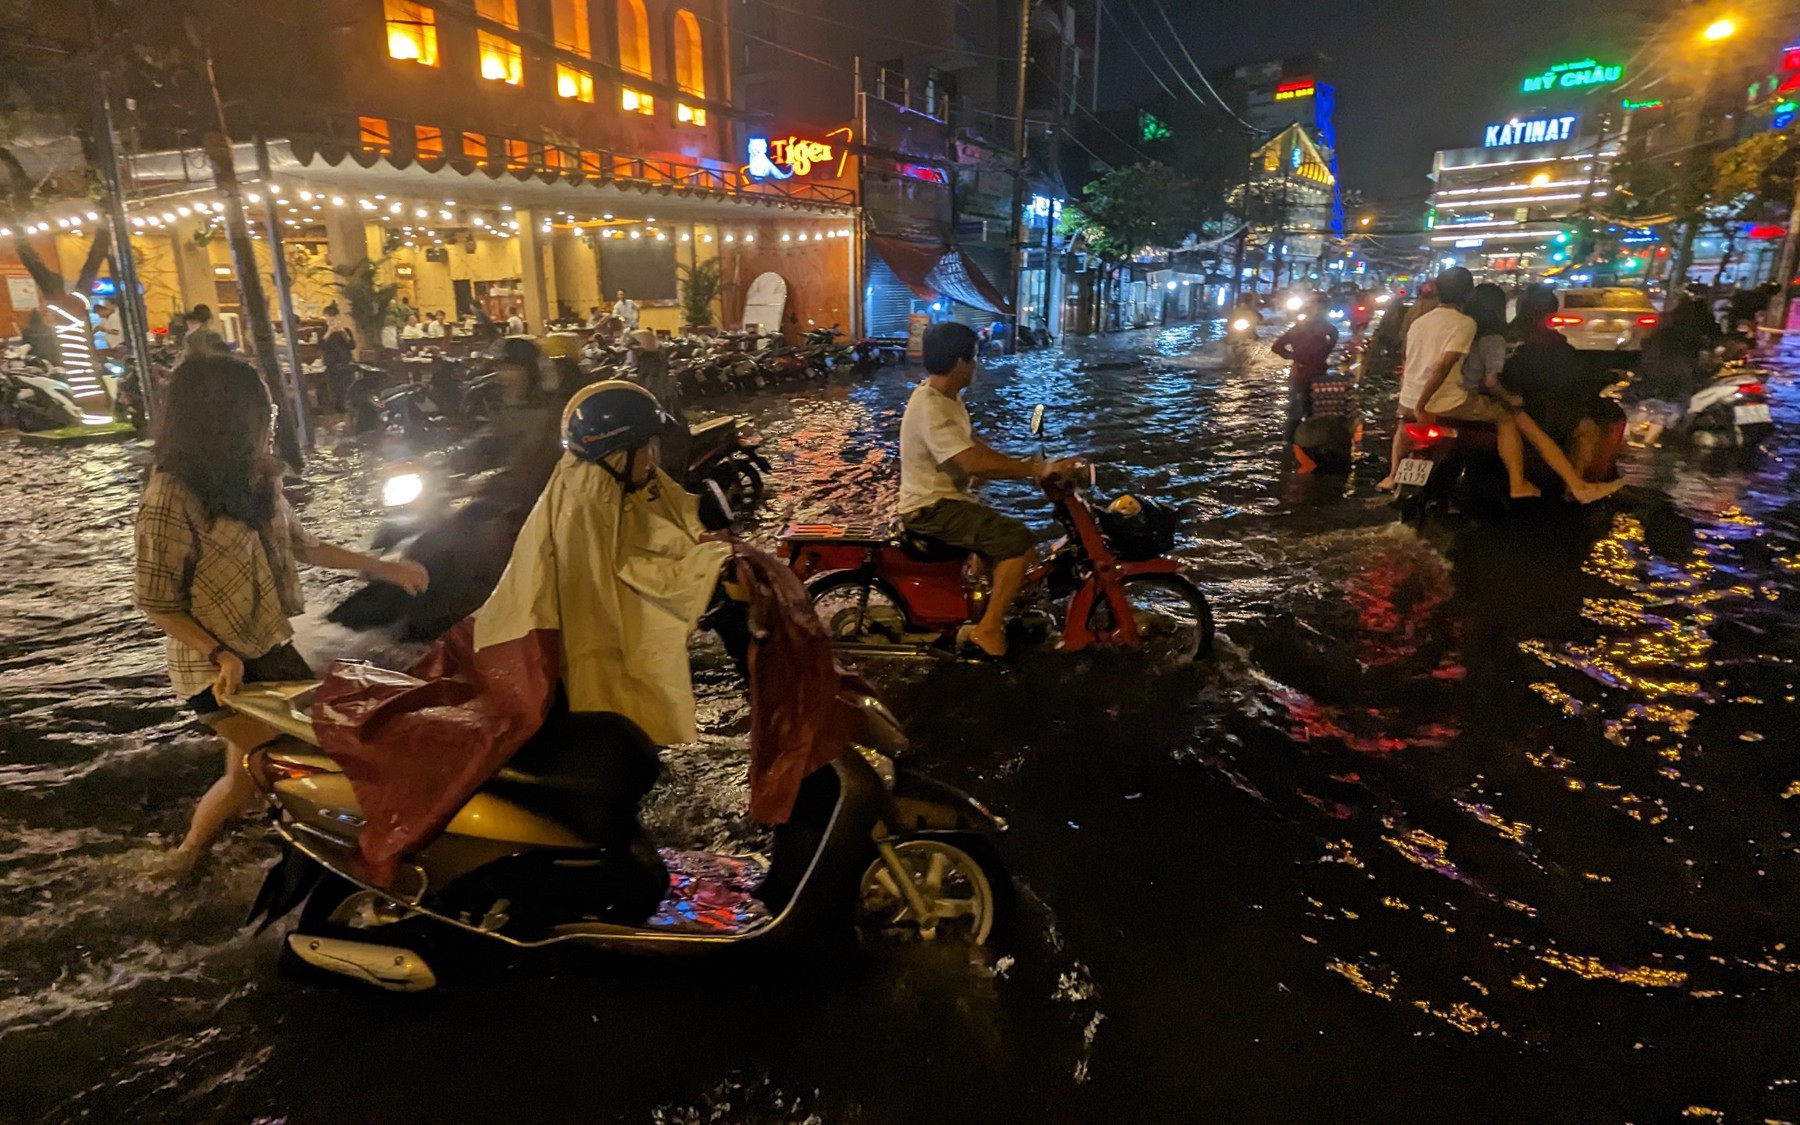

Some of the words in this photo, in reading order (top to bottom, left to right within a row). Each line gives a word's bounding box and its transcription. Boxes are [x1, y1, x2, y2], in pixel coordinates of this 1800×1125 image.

[1522, 72, 1557, 92] MỸ
[1559, 65, 1622, 87] CHÂU
[1484, 116, 1576, 147] KATINAT
[770, 136, 833, 176] Tiger
